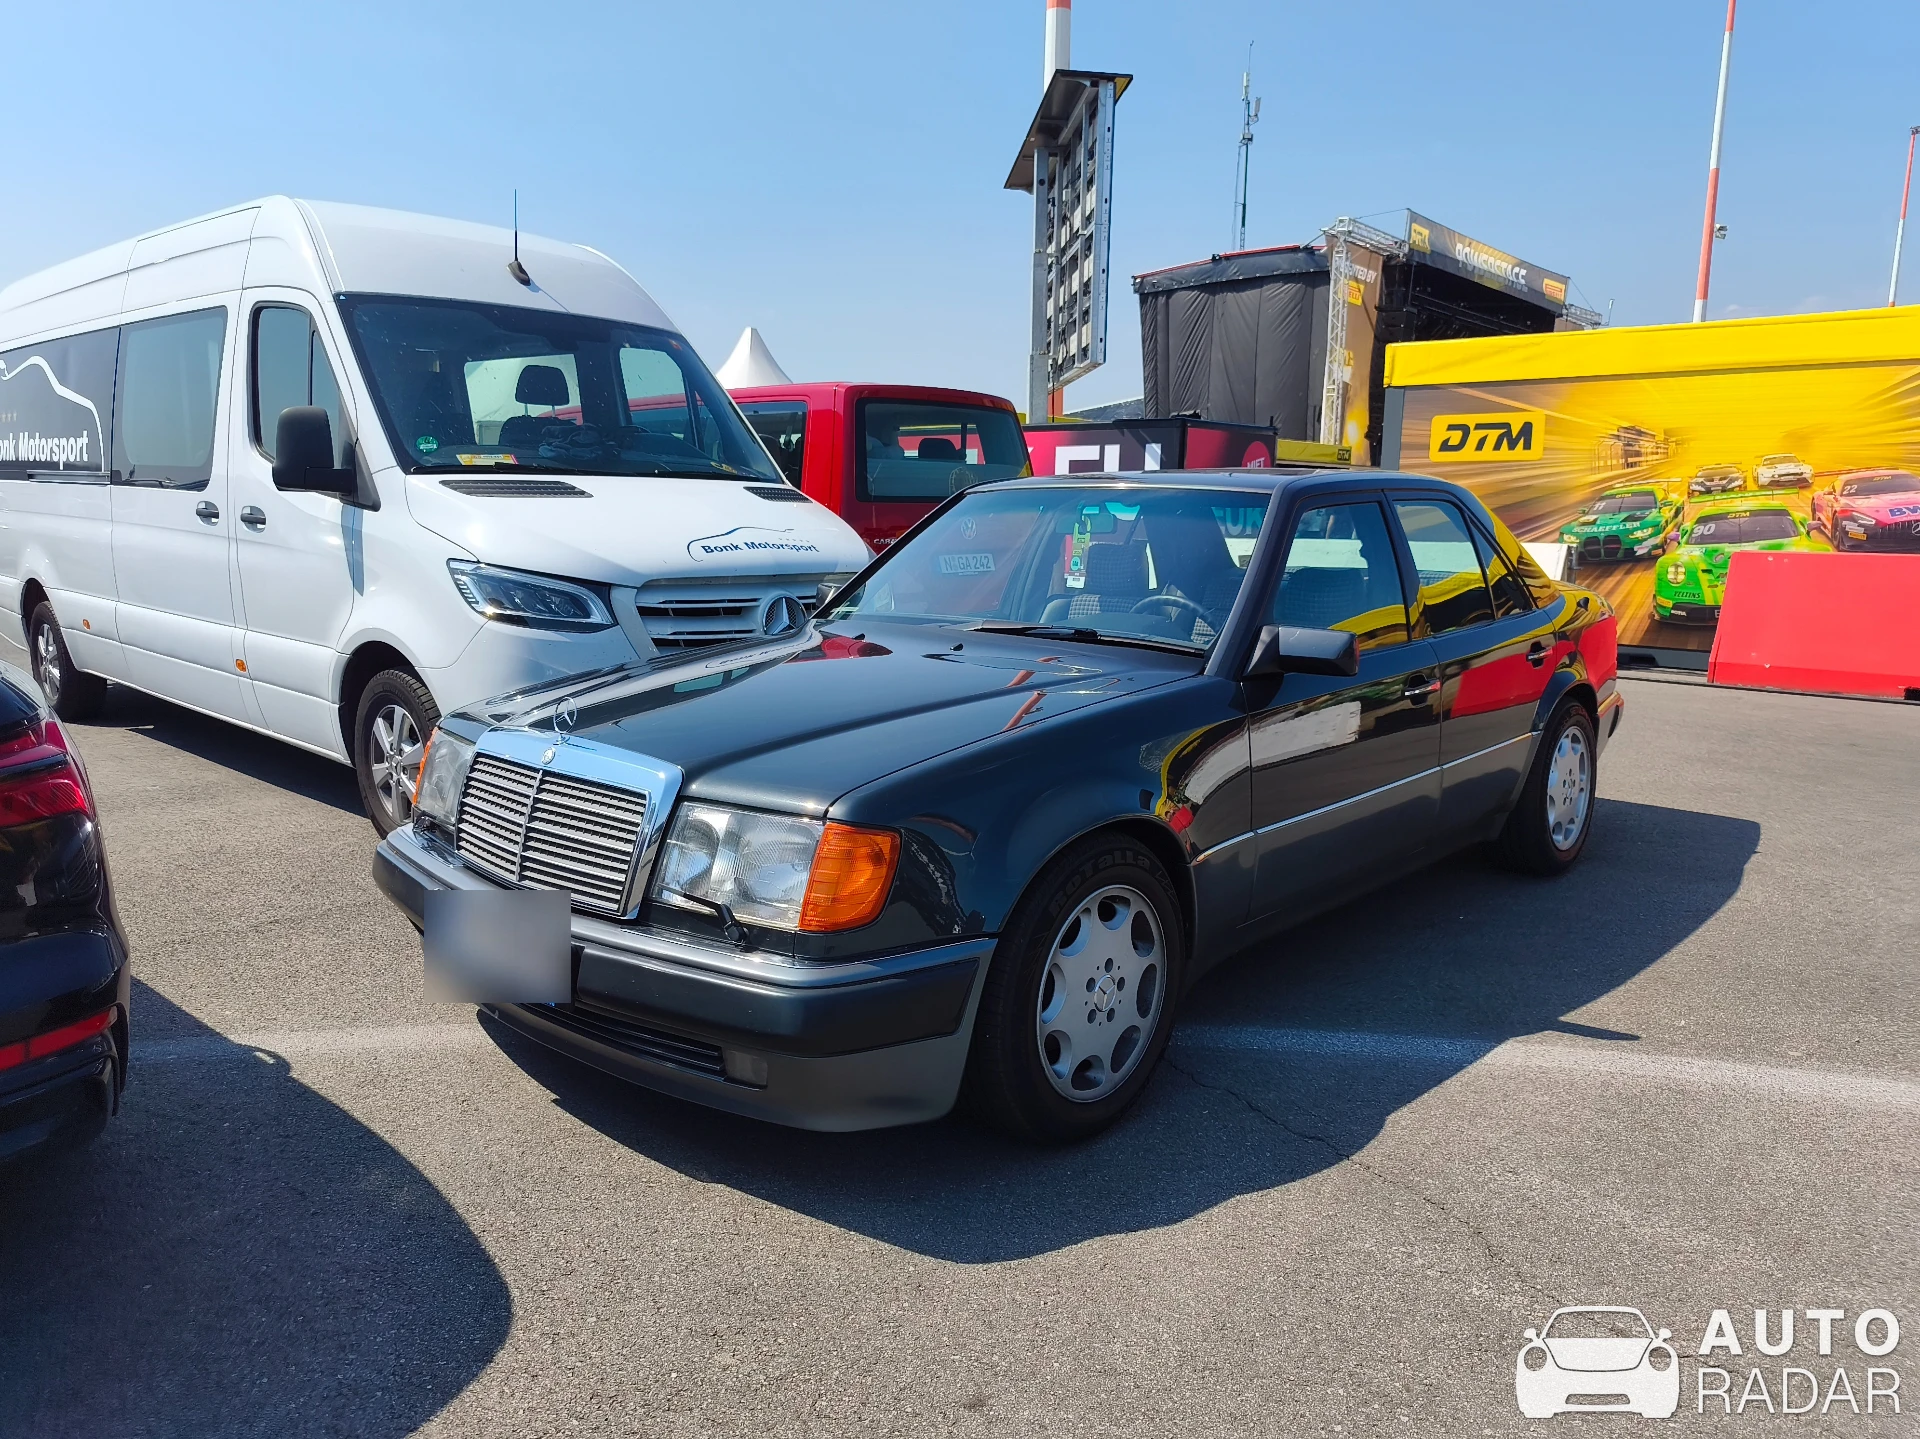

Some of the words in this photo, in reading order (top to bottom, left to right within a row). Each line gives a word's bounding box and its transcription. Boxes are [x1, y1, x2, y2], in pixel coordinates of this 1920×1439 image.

[1366, 270, 1377, 284] BY
[1438, 421, 1533, 452] DTM
[0, 432, 16, 461] onk
[19, 430, 89, 470] Motorsport
[1844, 484, 1858, 495] 22
[1888, 505, 1920, 518] BW
[1571, 521, 1642, 534] SCHAEFFLER
[1692, 523, 1716, 537] 90
[701, 542, 743, 554] Bonk
[743, 541, 820, 553] Motorsport
[973, 555, 991, 569] 242
